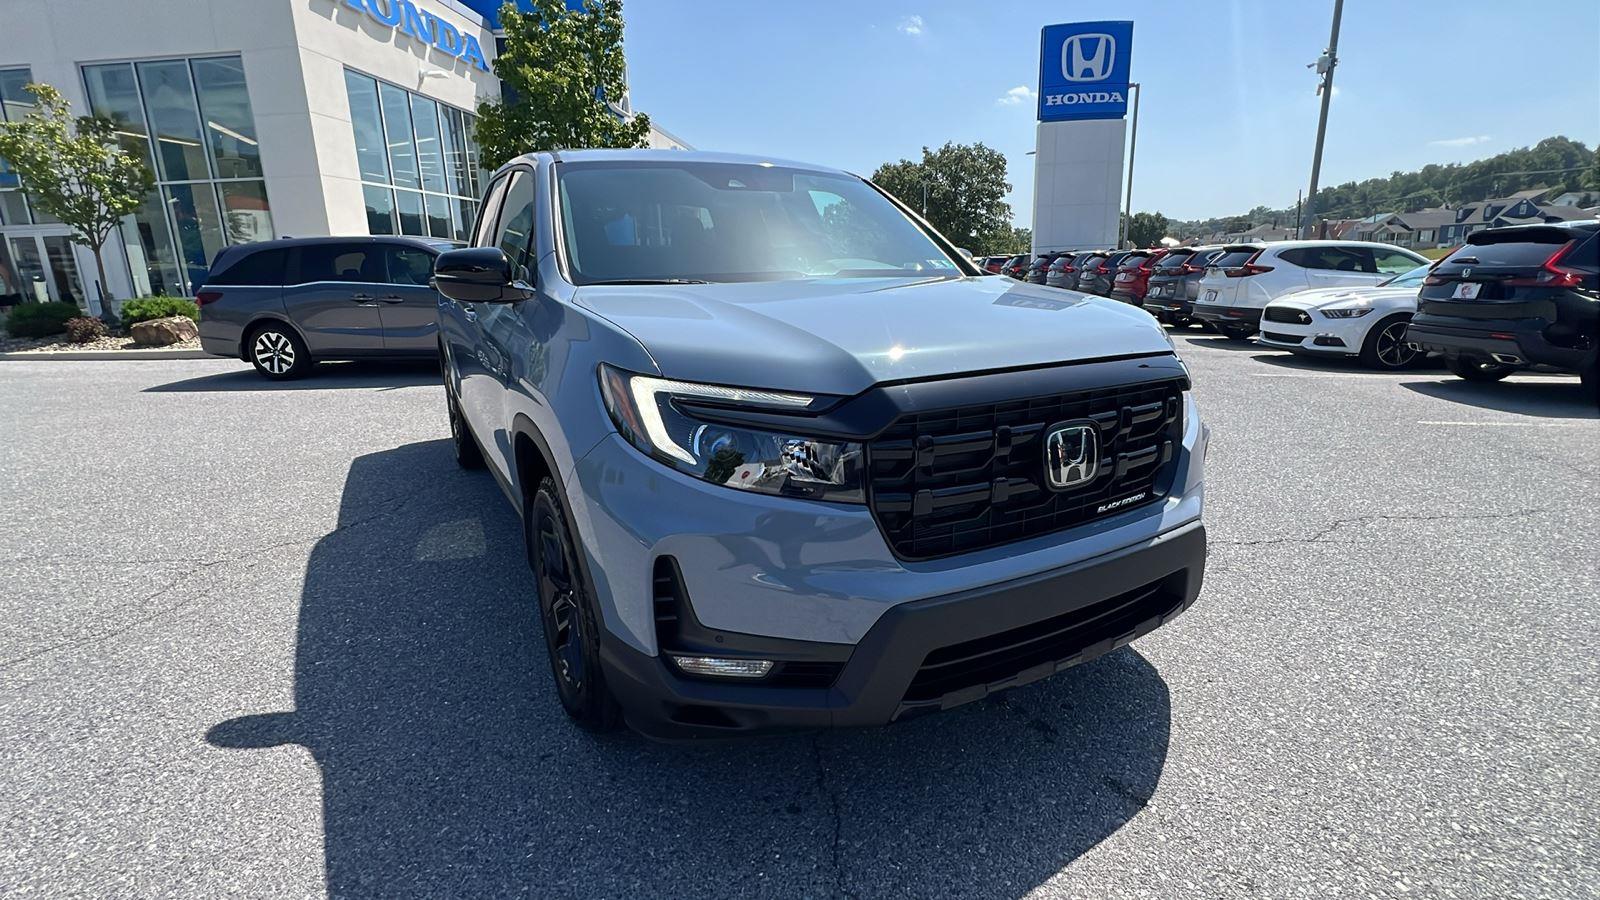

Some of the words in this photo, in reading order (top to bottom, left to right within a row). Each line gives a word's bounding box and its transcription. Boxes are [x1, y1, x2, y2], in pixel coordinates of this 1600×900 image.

[345, 0, 489, 72] ONDA
[1046, 92, 1125, 106] HONDA
[1097, 500, 1121, 513] BLACK
[1121, 492, 1146, 505] EDITION
